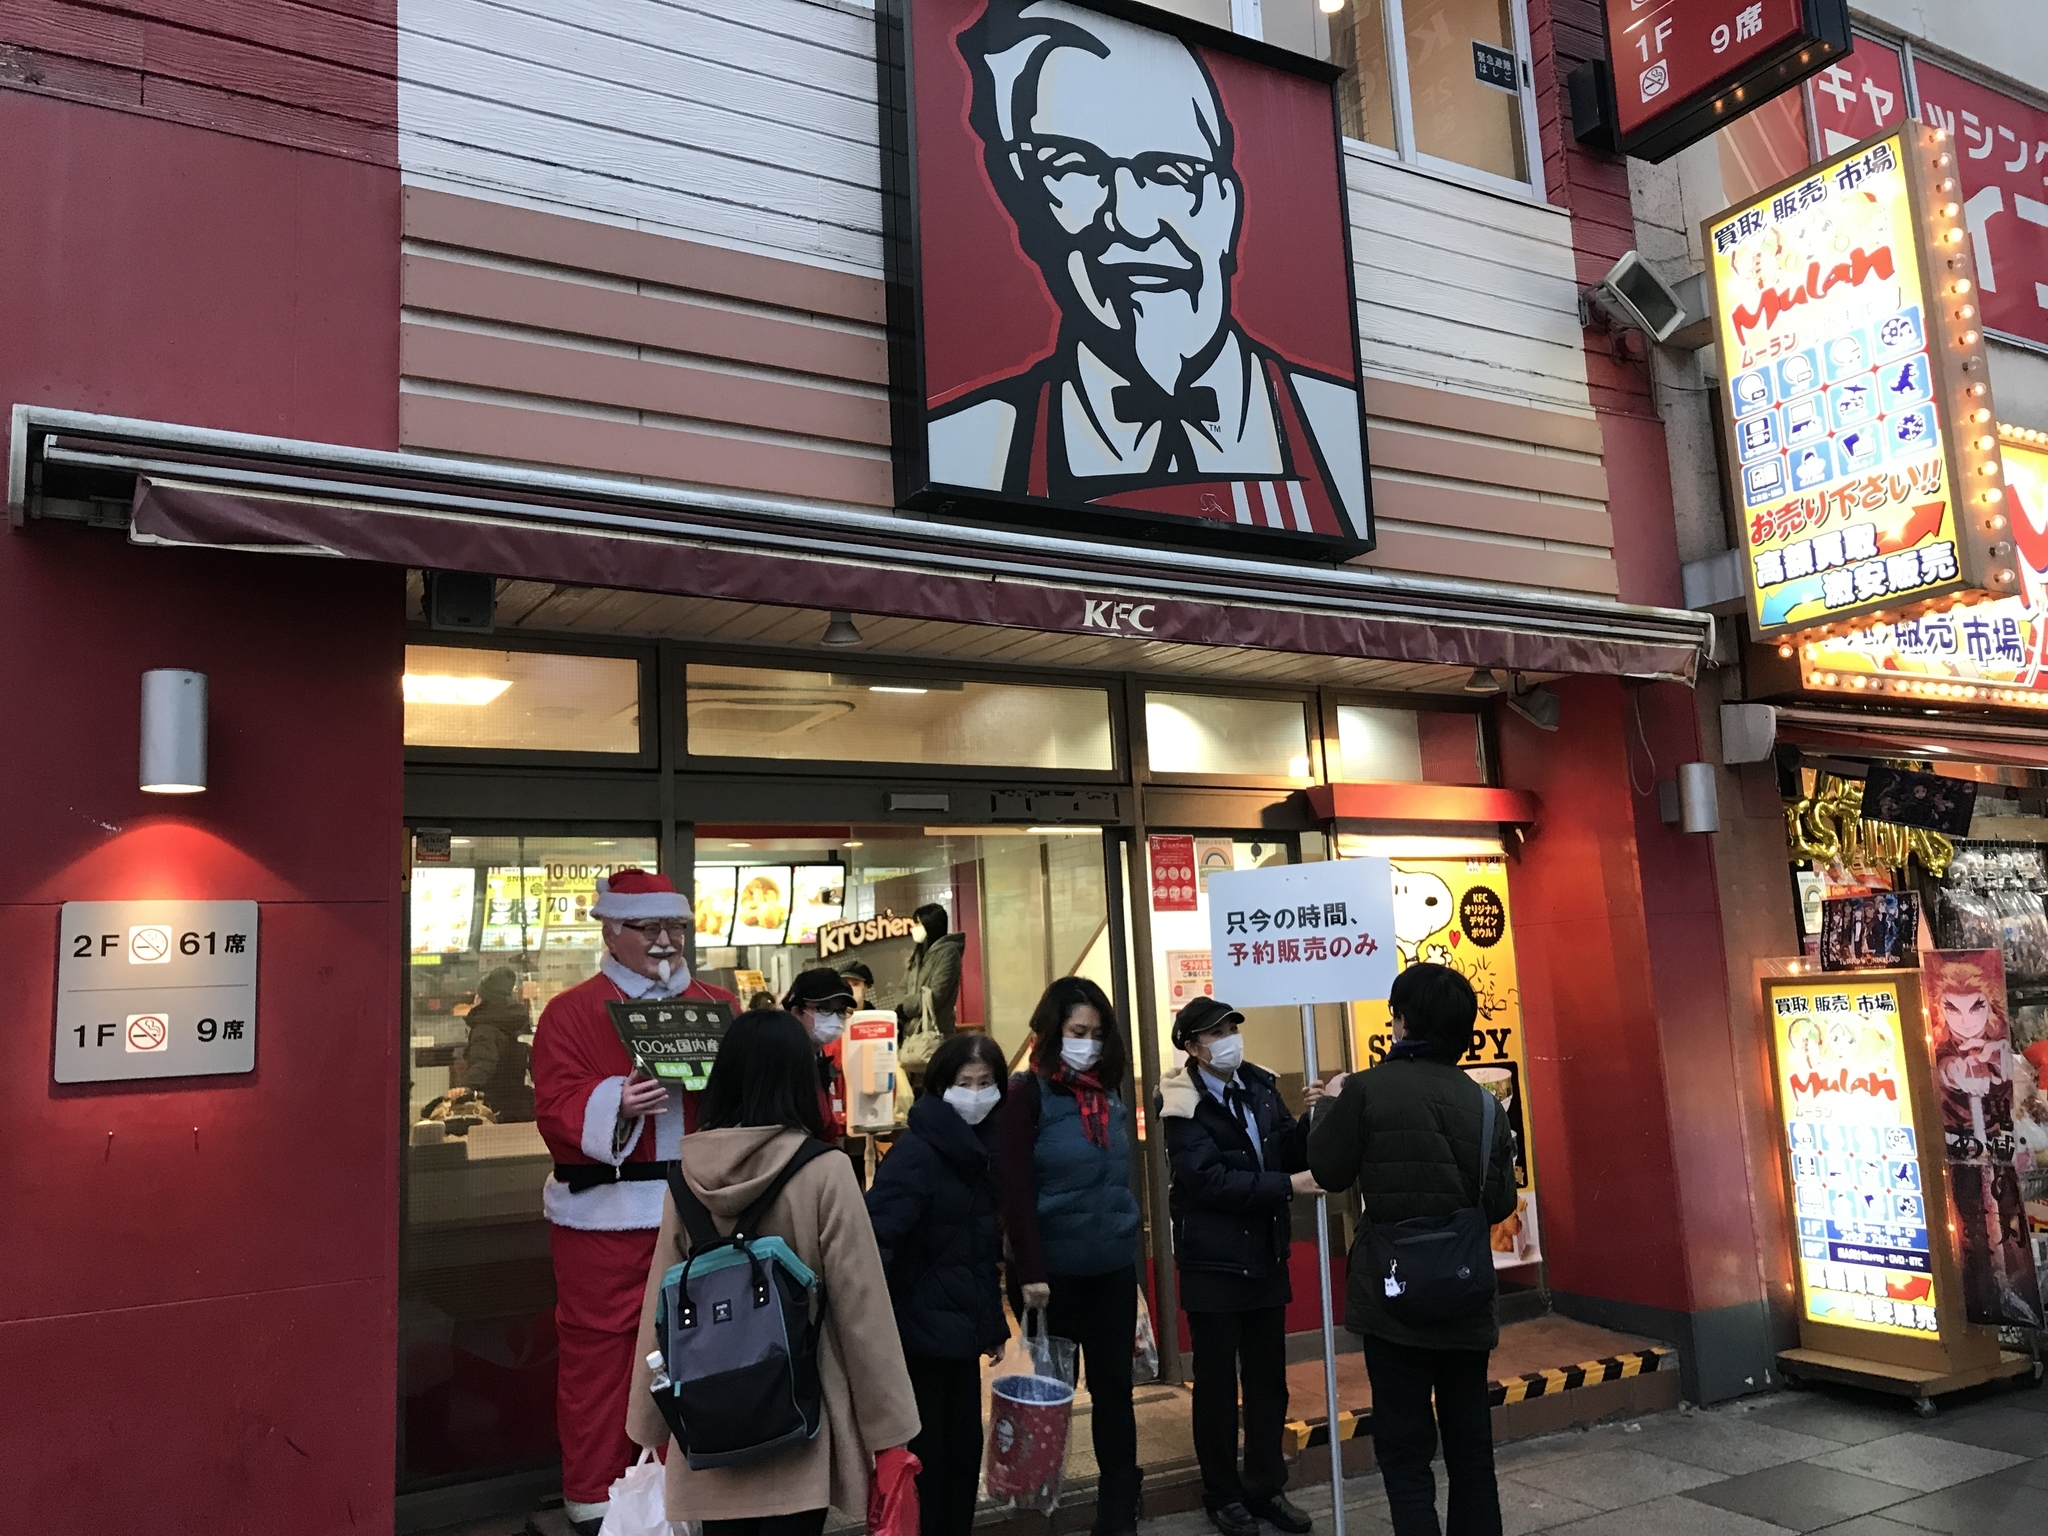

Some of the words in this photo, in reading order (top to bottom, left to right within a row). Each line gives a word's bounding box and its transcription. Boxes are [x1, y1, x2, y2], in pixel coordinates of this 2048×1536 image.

[1635, 17, 1673, 63] 1F
[1710, 1, 1763, 54] 9席
[1714, 209, 1763, 252] 買取
[1772, 176, 1826, 222] 販売
[1836, 144, 1895, 190] 市場
[1732, 245, 1895, 347] Mulan
[1740, 332, 1797, 369] ムーラン
[1082, 600, 1155, 632] KFC
[1963, 615, 2024, 662] 市場
[1464, 904, 1500, 915] オリジナル
[1472, 893, 1489, 903] KFC
[1226, 901, 1358, 936] 只今の時間、
[1469, 916, 1498, 926] デザイン
[73, 934, 120, 957] 2F
[179, 931, 247, 956] 61席
[1227, 932, 1379, 967] 予約販売のみ
[1775, 996, 1808, 1015] 買取
[1814, 994, 1850, 1013] 販売
[1856, 993, 1896, 1013] 市場
[73, 1023, 117, 1048] 1F
[197, 1018, 245, 1042] 9席
[1790, 1068, 1897, 1102] Mulan
